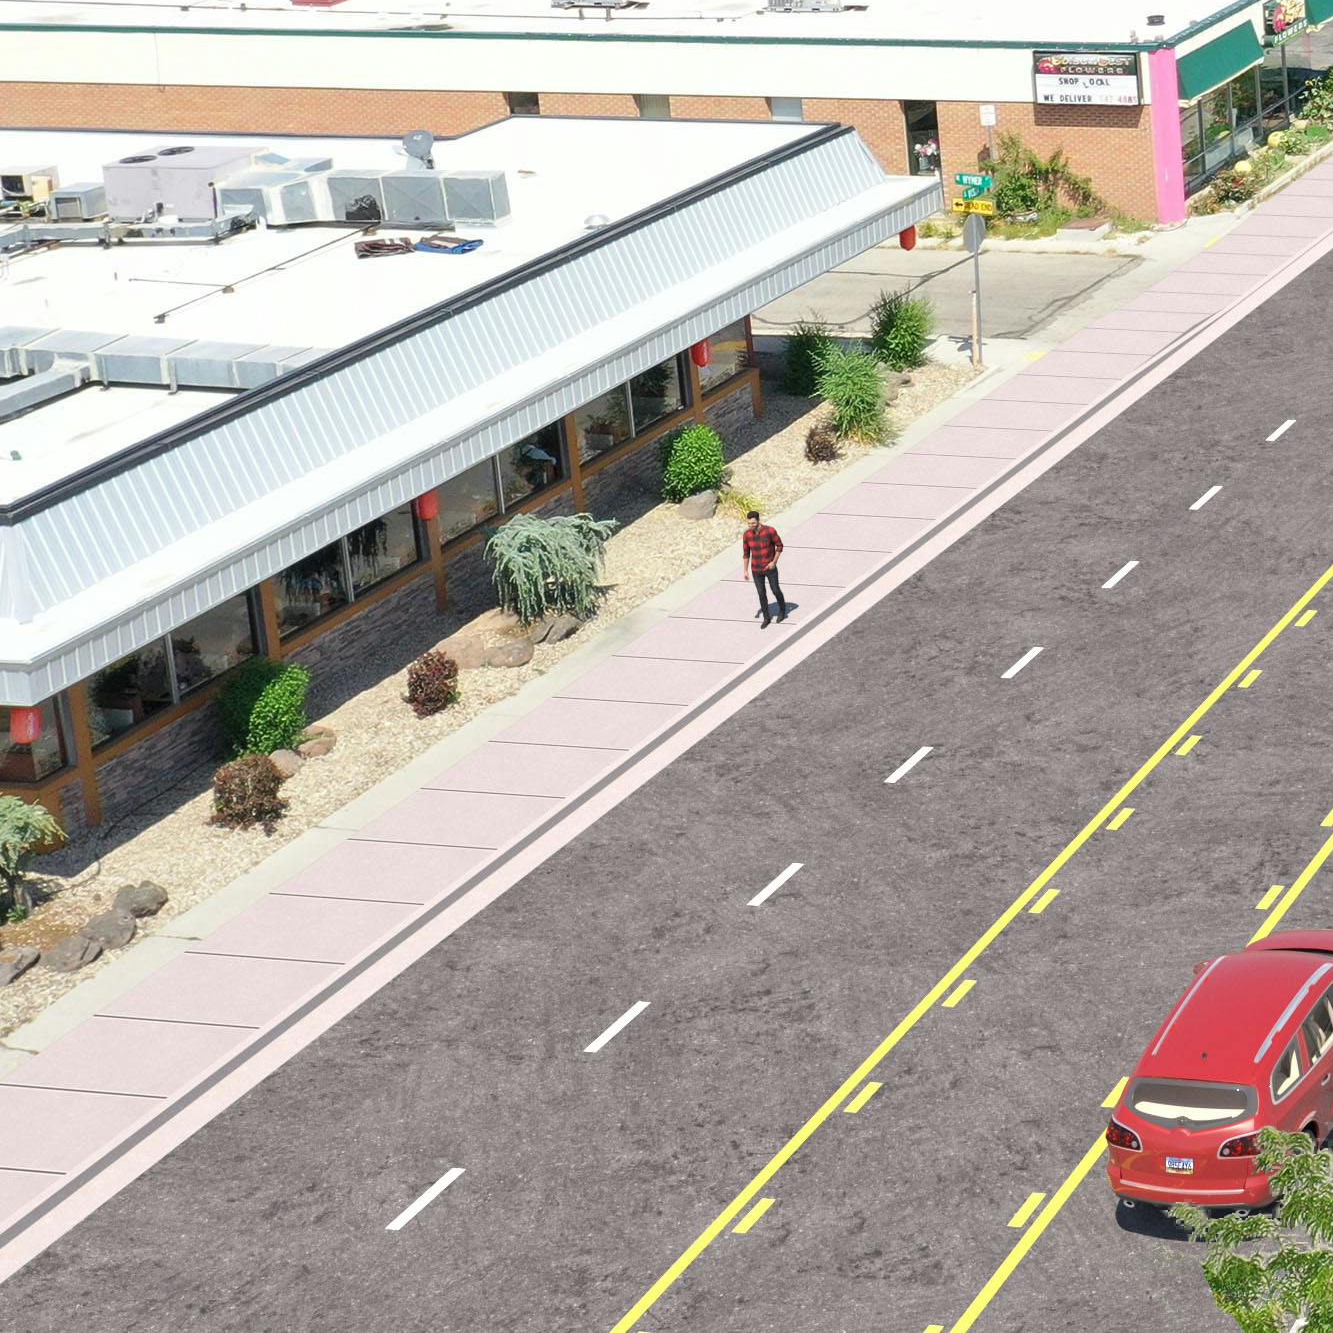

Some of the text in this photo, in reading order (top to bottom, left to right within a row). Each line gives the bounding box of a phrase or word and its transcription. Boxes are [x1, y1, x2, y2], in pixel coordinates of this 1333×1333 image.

[1083, 79, 1110, 88] LOCAL
[1044, 94, 1054, 102] WE
[964, 201, 979, 210] DEAD
